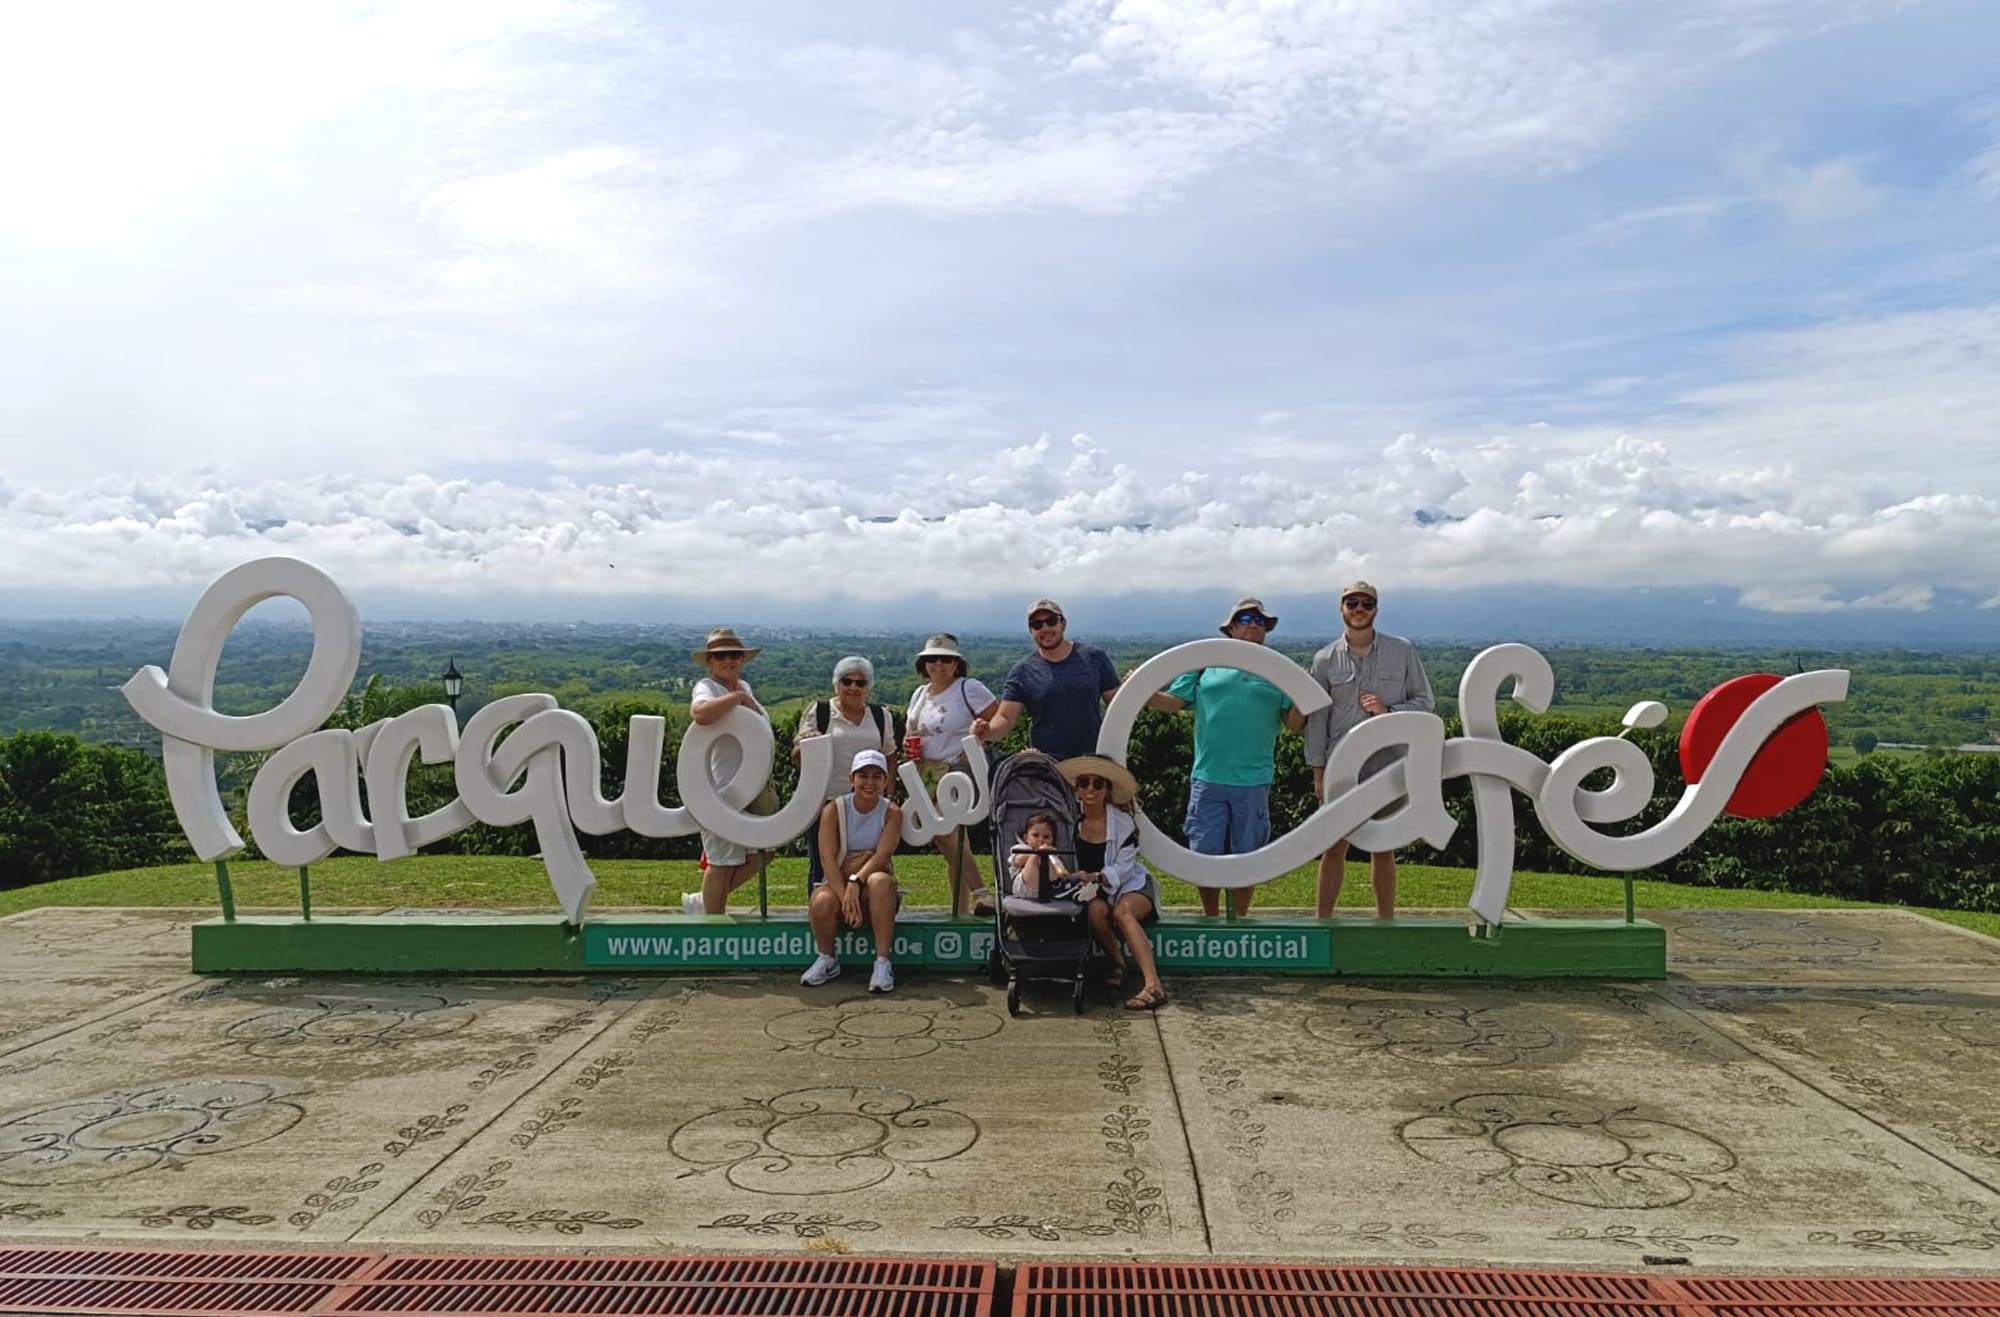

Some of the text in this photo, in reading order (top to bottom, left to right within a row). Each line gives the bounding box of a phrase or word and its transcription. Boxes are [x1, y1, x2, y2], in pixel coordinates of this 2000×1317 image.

[122, 556, 1849, 926] Parque del Café
